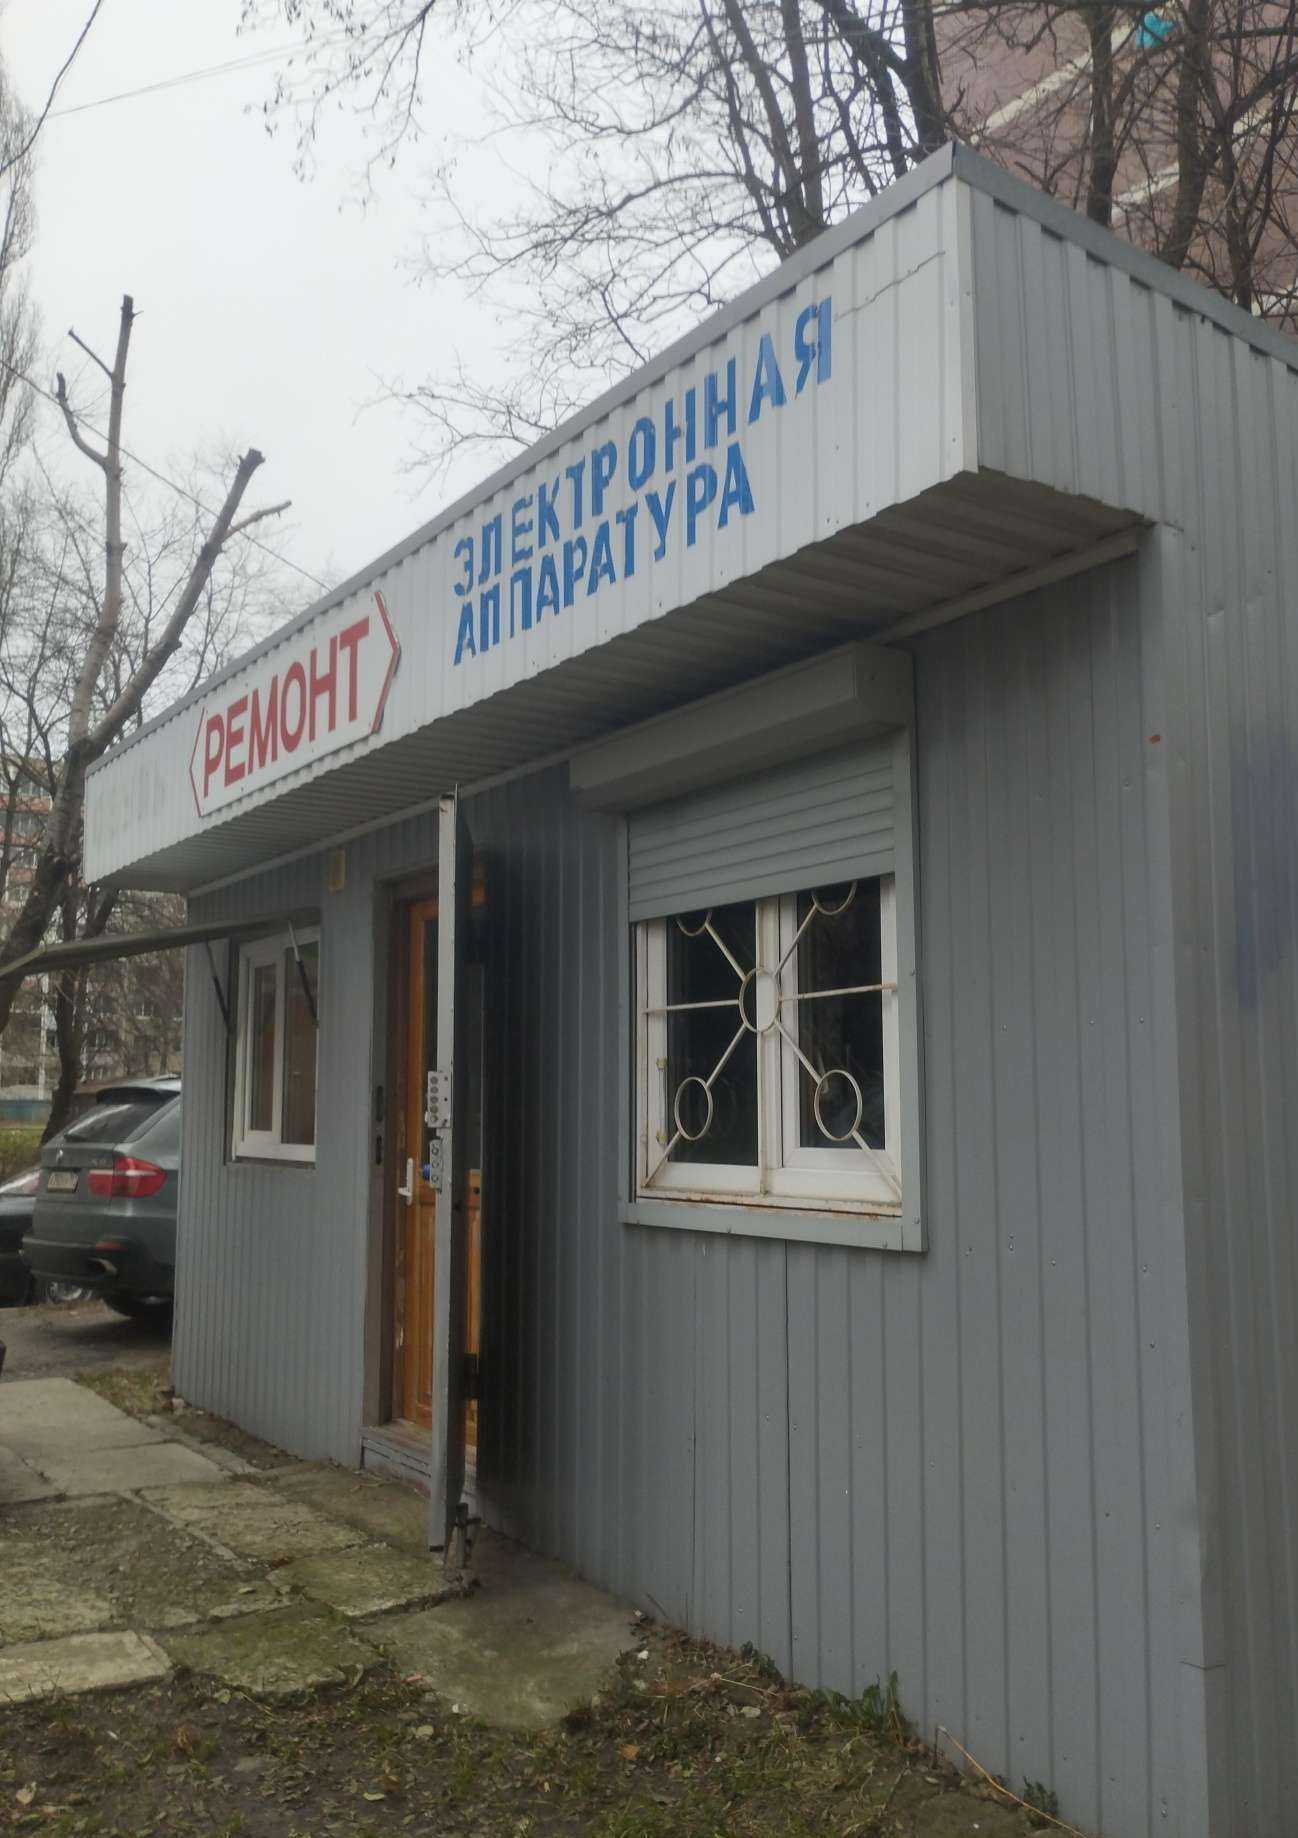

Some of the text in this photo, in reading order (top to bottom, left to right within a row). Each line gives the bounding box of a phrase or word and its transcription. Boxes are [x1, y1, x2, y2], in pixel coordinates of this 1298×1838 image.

[453, 297, 831, 597] ЭЛЕКТРОННАЯ
[453, 442, 755, 666] АППАРАТУРА
[203, 616, 370, 797] РЕМОНТ
